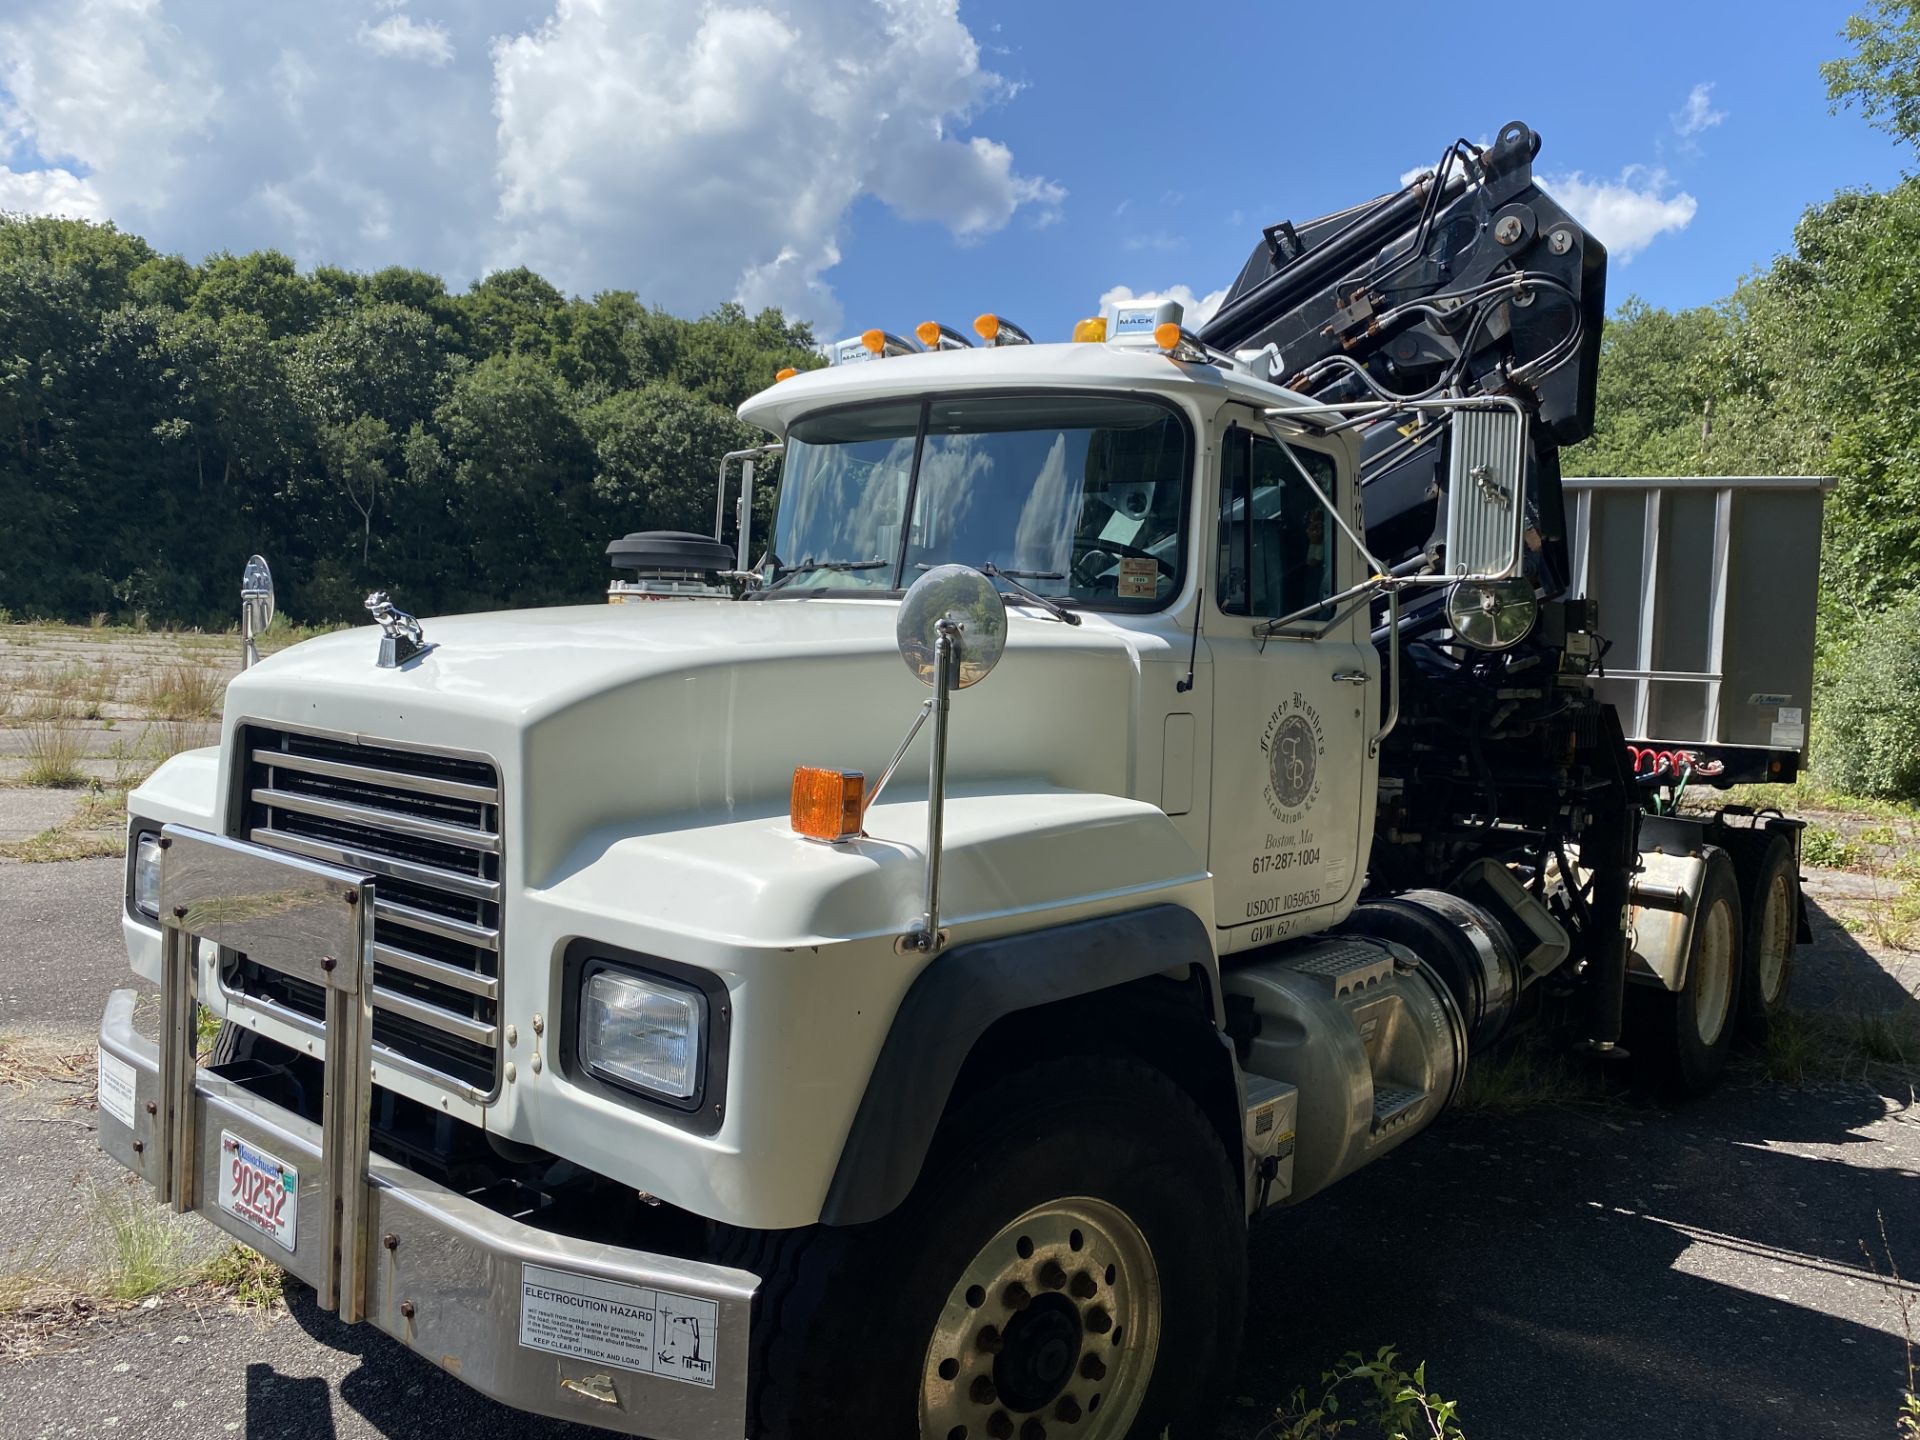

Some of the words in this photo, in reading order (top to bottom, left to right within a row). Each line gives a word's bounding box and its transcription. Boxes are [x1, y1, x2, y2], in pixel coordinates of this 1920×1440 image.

[842, 352, 867, 361] MACK
[1293, 691, 1325, 755] Brothers
[1264, 833, 1296, 850] Boston,
[1252, 847, 1321, 874] 617-287-1004
[1246, 896, 1281, 917] USDOT
[1283, 888, 1321, 910] 1059636
[1251, 924, 1275, 942] GVW
[231, 1158, 287, 1228] 90252
[525, 1286, 608, 1313] ELECTROCUTION
[610, 1306, 653, 1321] HAZARD
[554, 1313, 568, 1321] from
[568, 1317, 590, 1326] contact
[590, 1321, 603, 1329] with
[610, 1326, 638, 1337] proximity
[533, 1336, 550, 1345] KEEP
[551, 1340, 572, 1351] CLEAR
[583, 1347, 605, 1358] TRUCK
[606, 1353, 620, 1361] AND
[621, 1356, 640, 1366] LOAD
